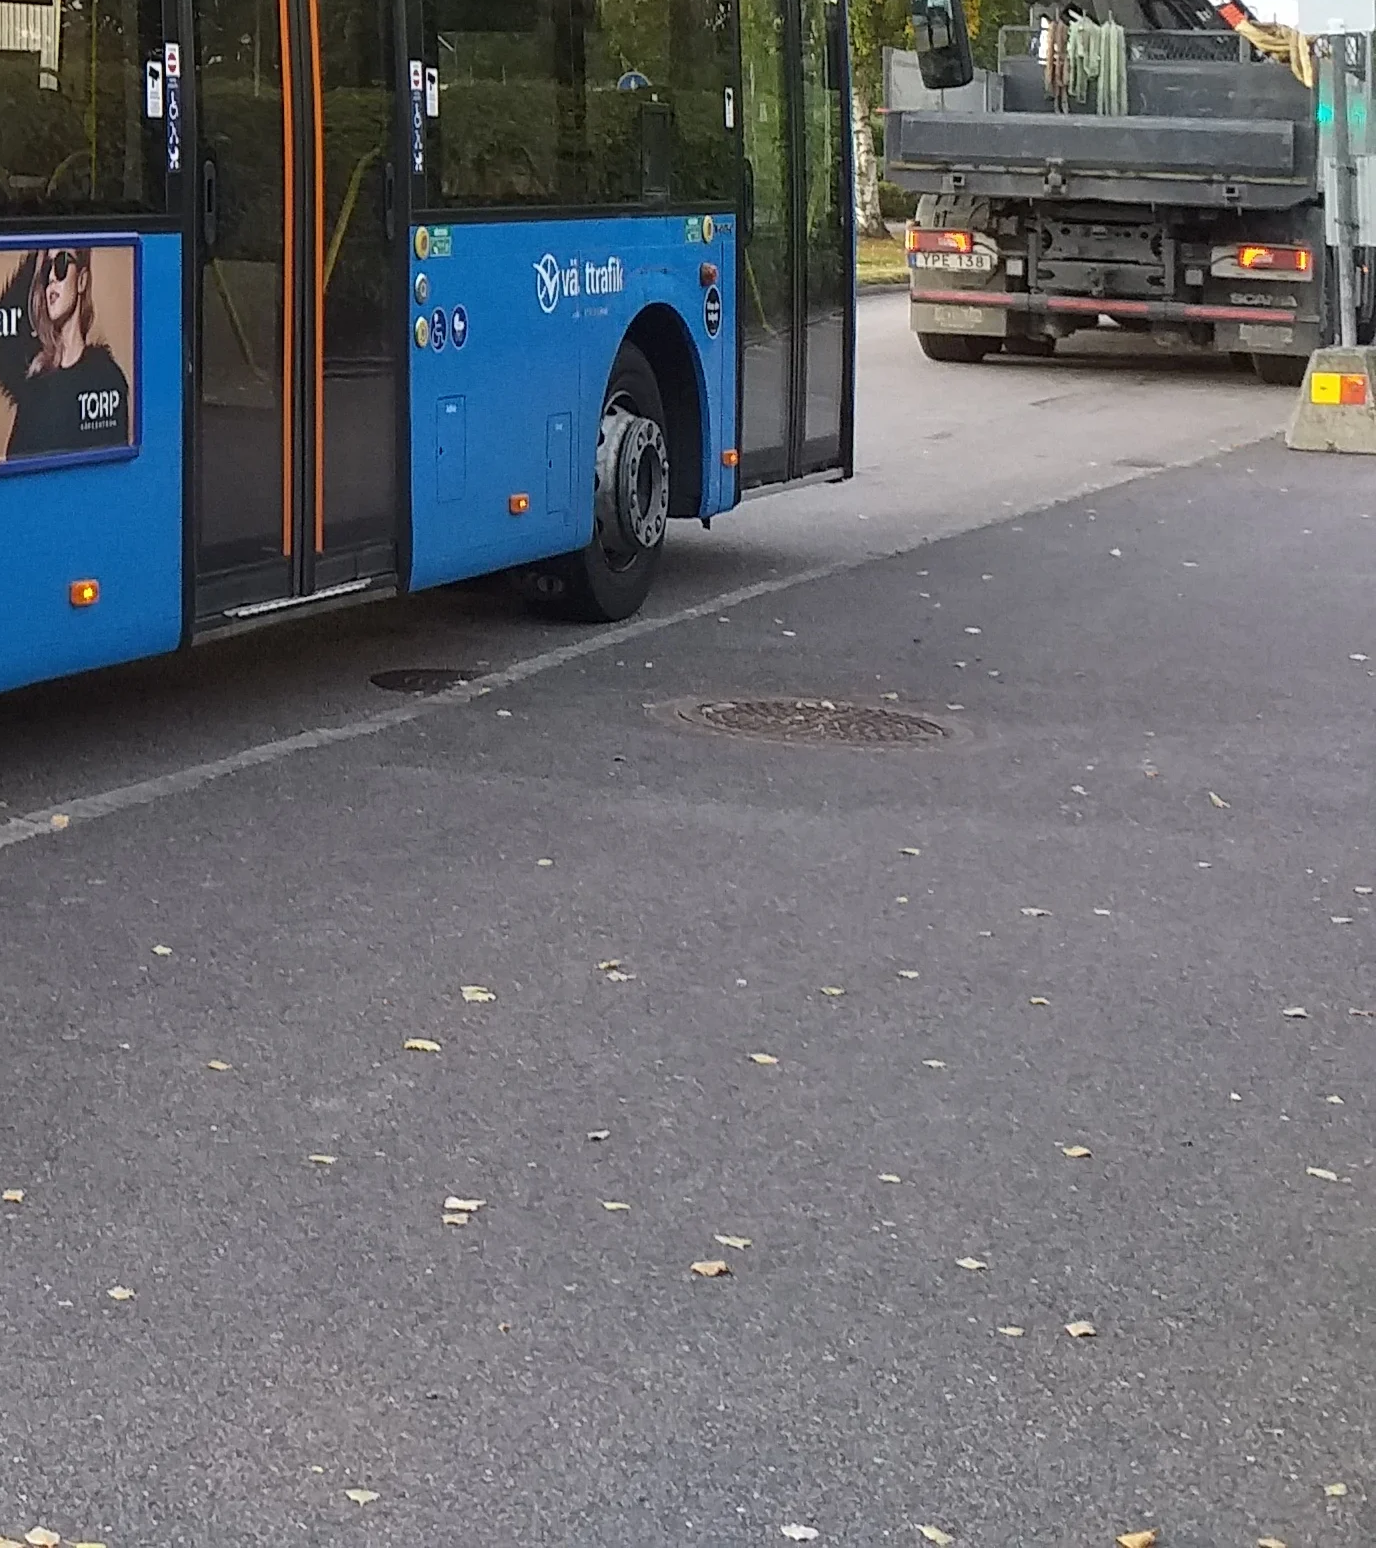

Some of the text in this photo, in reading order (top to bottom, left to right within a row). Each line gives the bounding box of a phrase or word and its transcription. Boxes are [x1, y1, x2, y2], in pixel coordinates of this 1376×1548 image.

[923, 254, 984, 268] YPE 138
[561, 256, 623, 297] vättrafik
[78, 390, 119, 420] TORP
